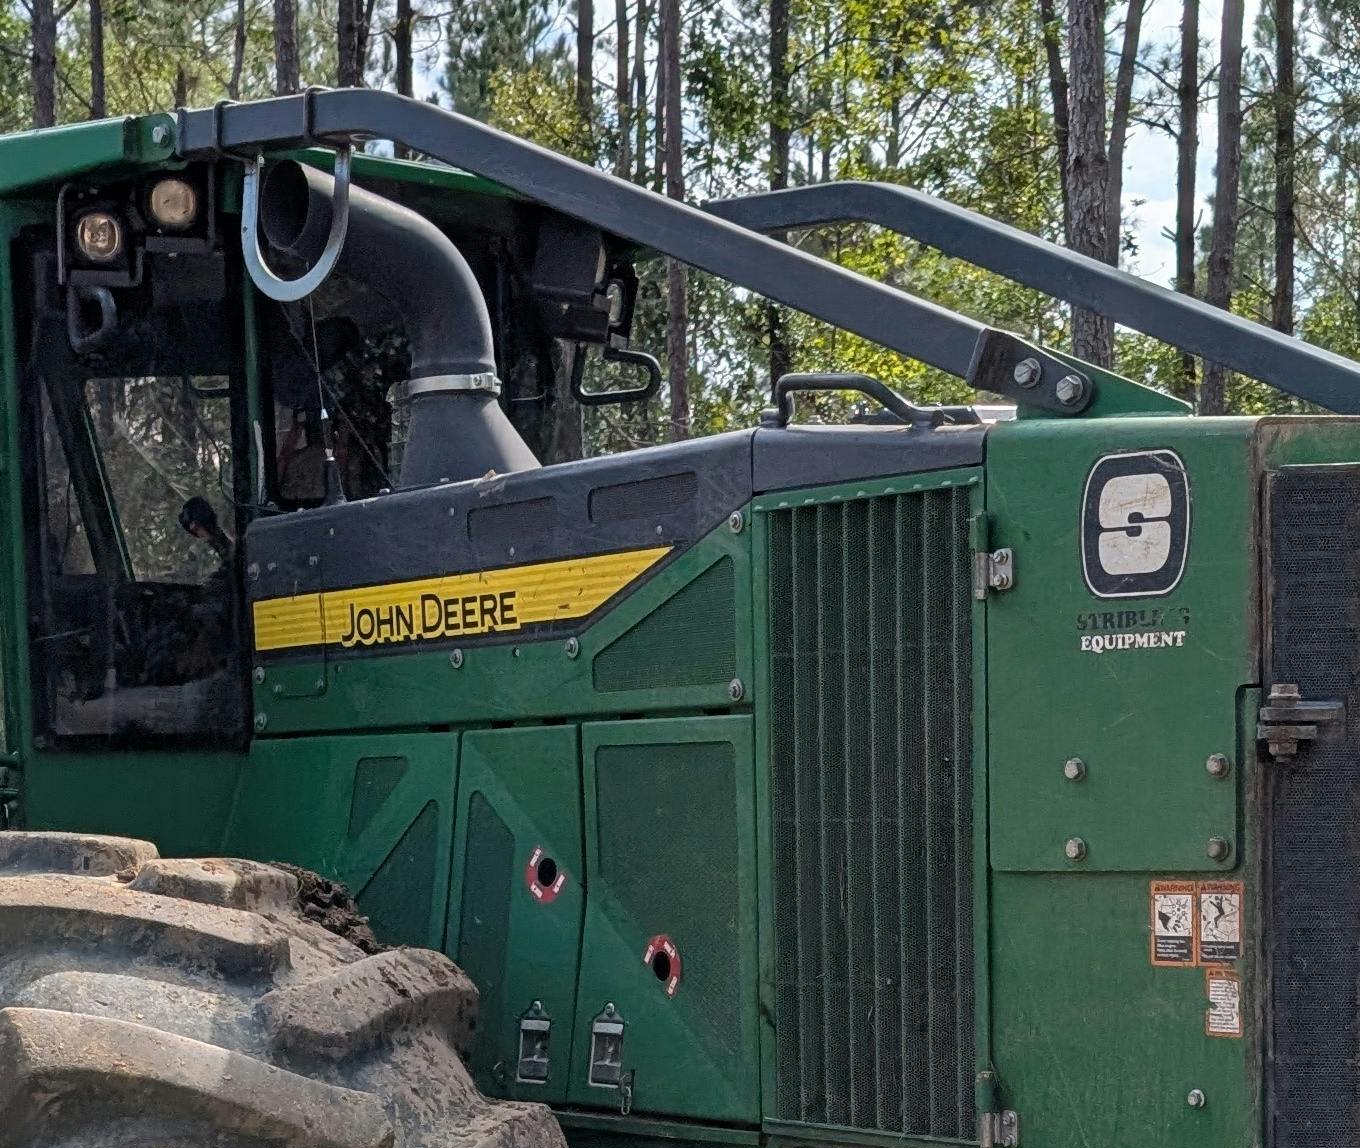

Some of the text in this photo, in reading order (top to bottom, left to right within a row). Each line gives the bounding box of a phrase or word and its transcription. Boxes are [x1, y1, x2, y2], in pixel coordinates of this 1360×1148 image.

[341, 591, 519, 643] JOHN DEERE
[1080, 630, 1186, 654] EQUIPMENT
